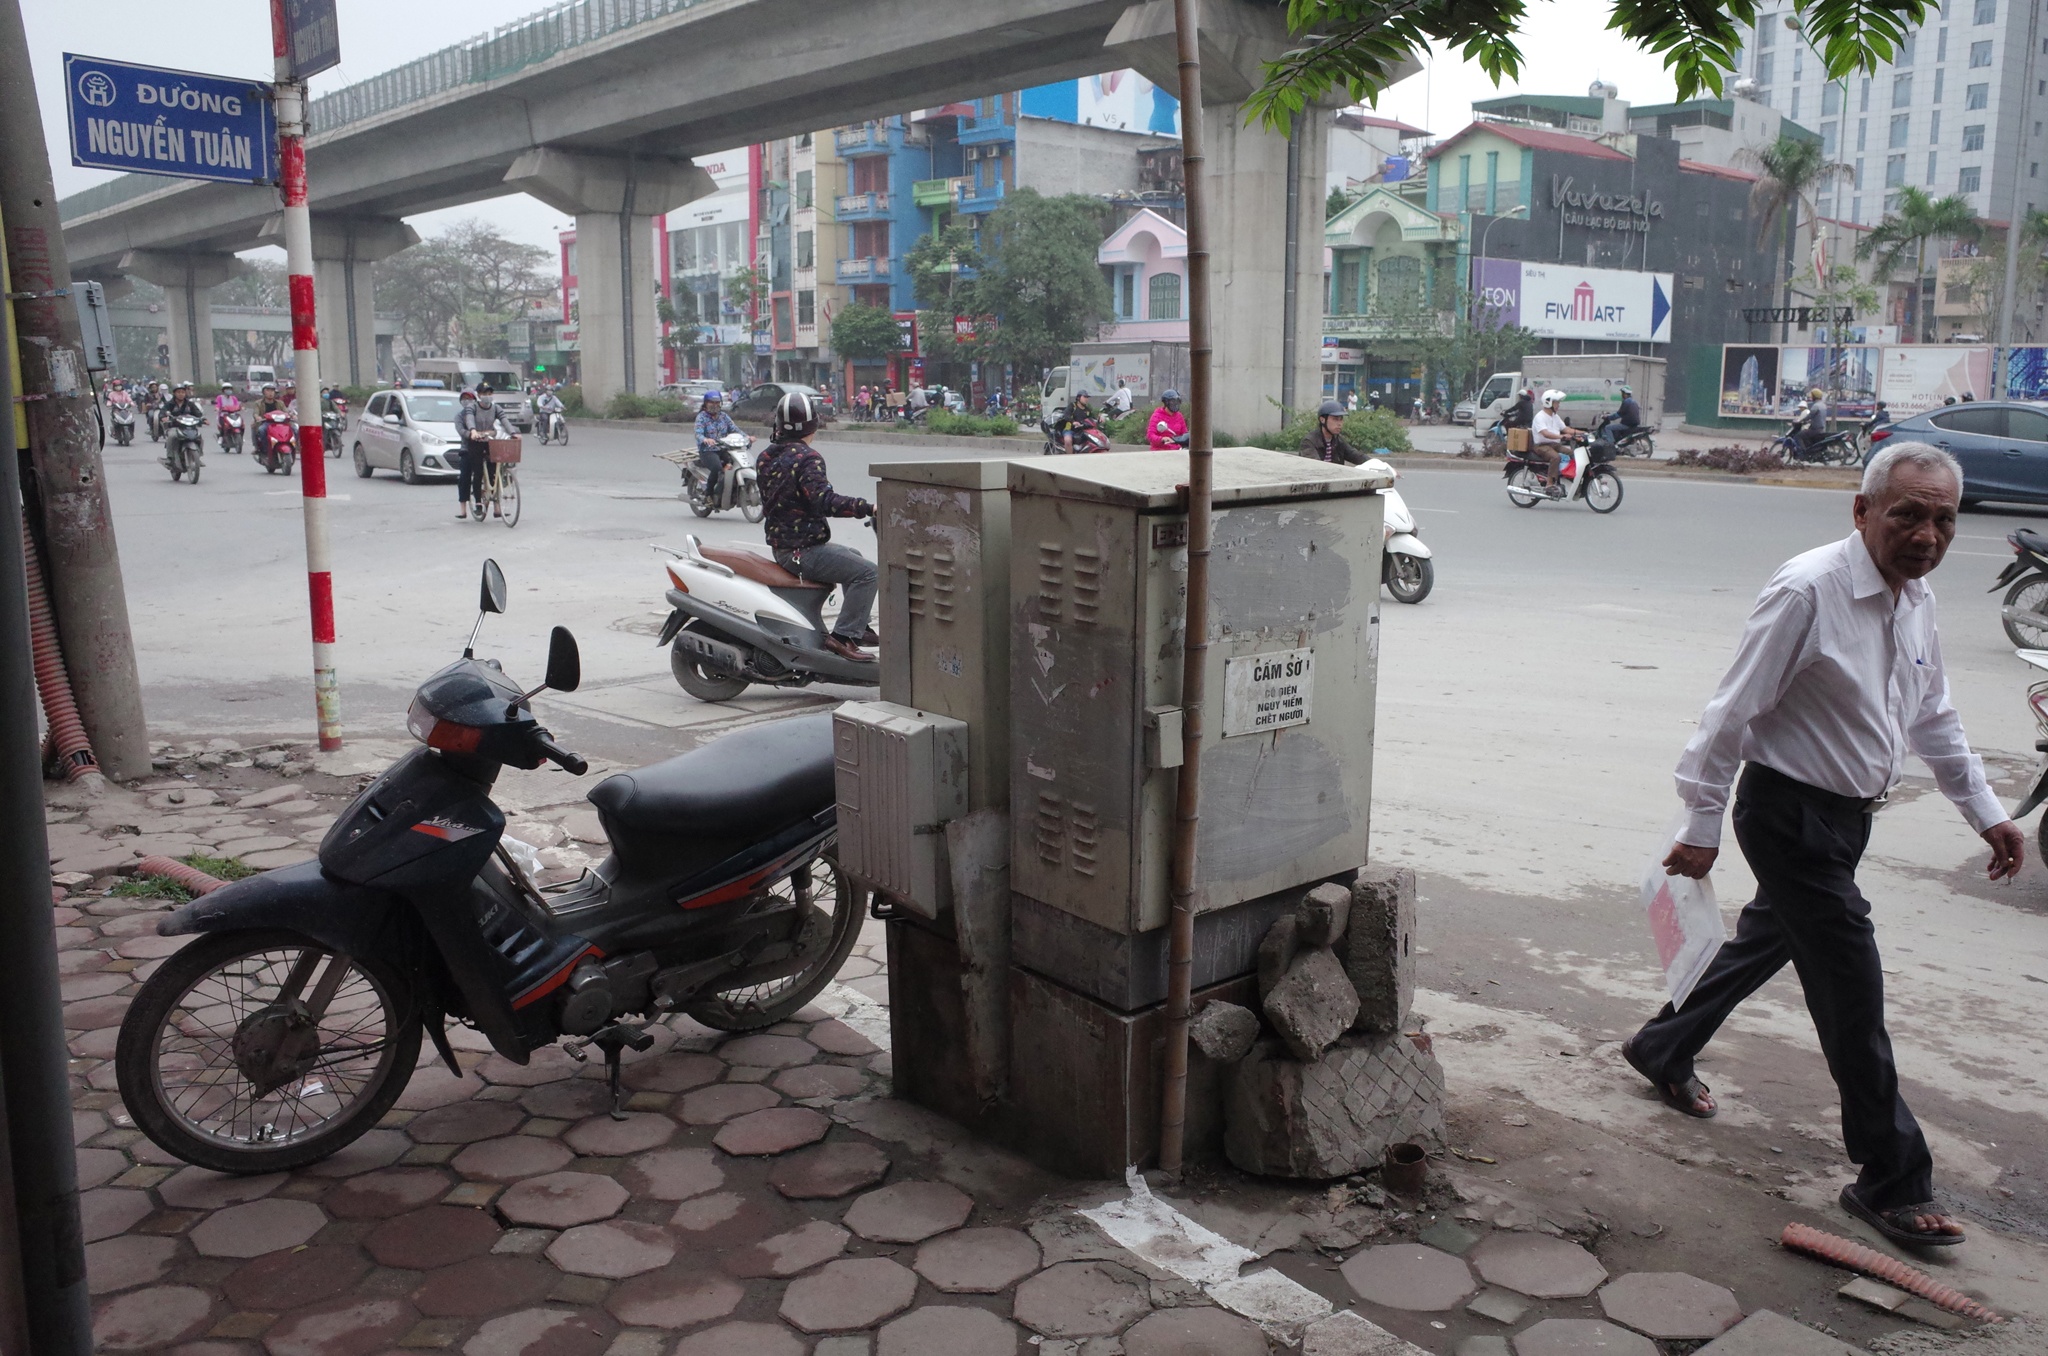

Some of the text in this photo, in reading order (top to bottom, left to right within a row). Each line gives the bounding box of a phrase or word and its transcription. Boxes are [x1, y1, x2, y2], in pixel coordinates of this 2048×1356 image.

[136, 81, 242, 117] ĐƯỜNG
[87, 114, 252, 170] NGUYỄN TUÂN
[704, 163, 726, 174] NDA
[1553, 173, 1665, 219] Vuvuzela
[1545, 287, 1626, 323] FIVIMART
[1912, 393, 1948, 401] HOTLINE
[1253, 659, 1282, 682] CẤM
[1286, 657, 1303, 677] SỜ
[1257, 700, 1281, 713] NGUY
[432, 816, 463, 830] Viva
